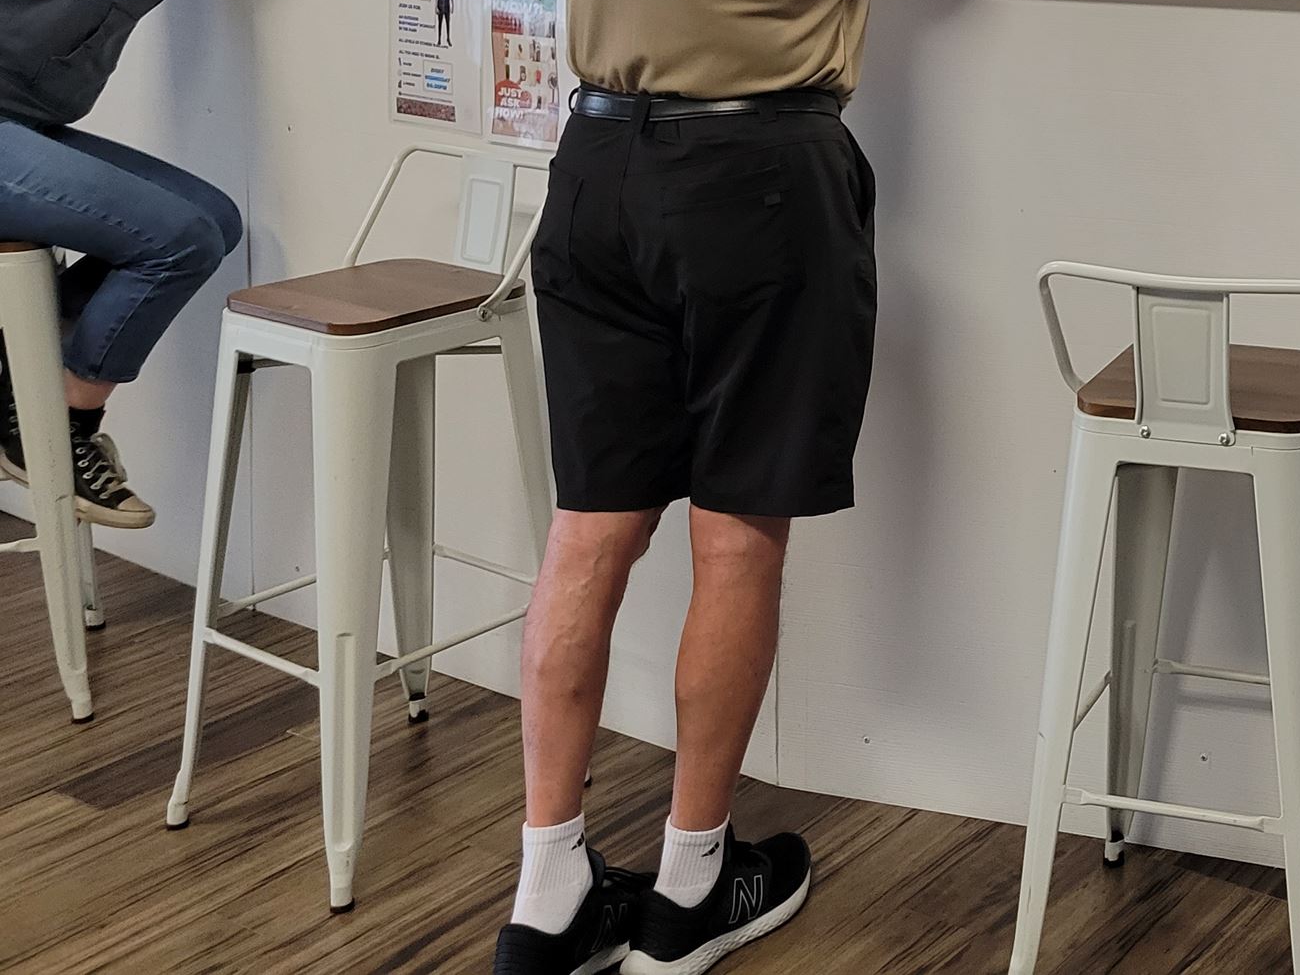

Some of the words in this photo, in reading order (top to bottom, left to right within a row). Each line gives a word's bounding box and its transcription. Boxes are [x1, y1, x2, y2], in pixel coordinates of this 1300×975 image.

[498, 87, 522, 98] JUST
[500, 98, 521, 108] ASK
[728, 874, 764, 925] N
